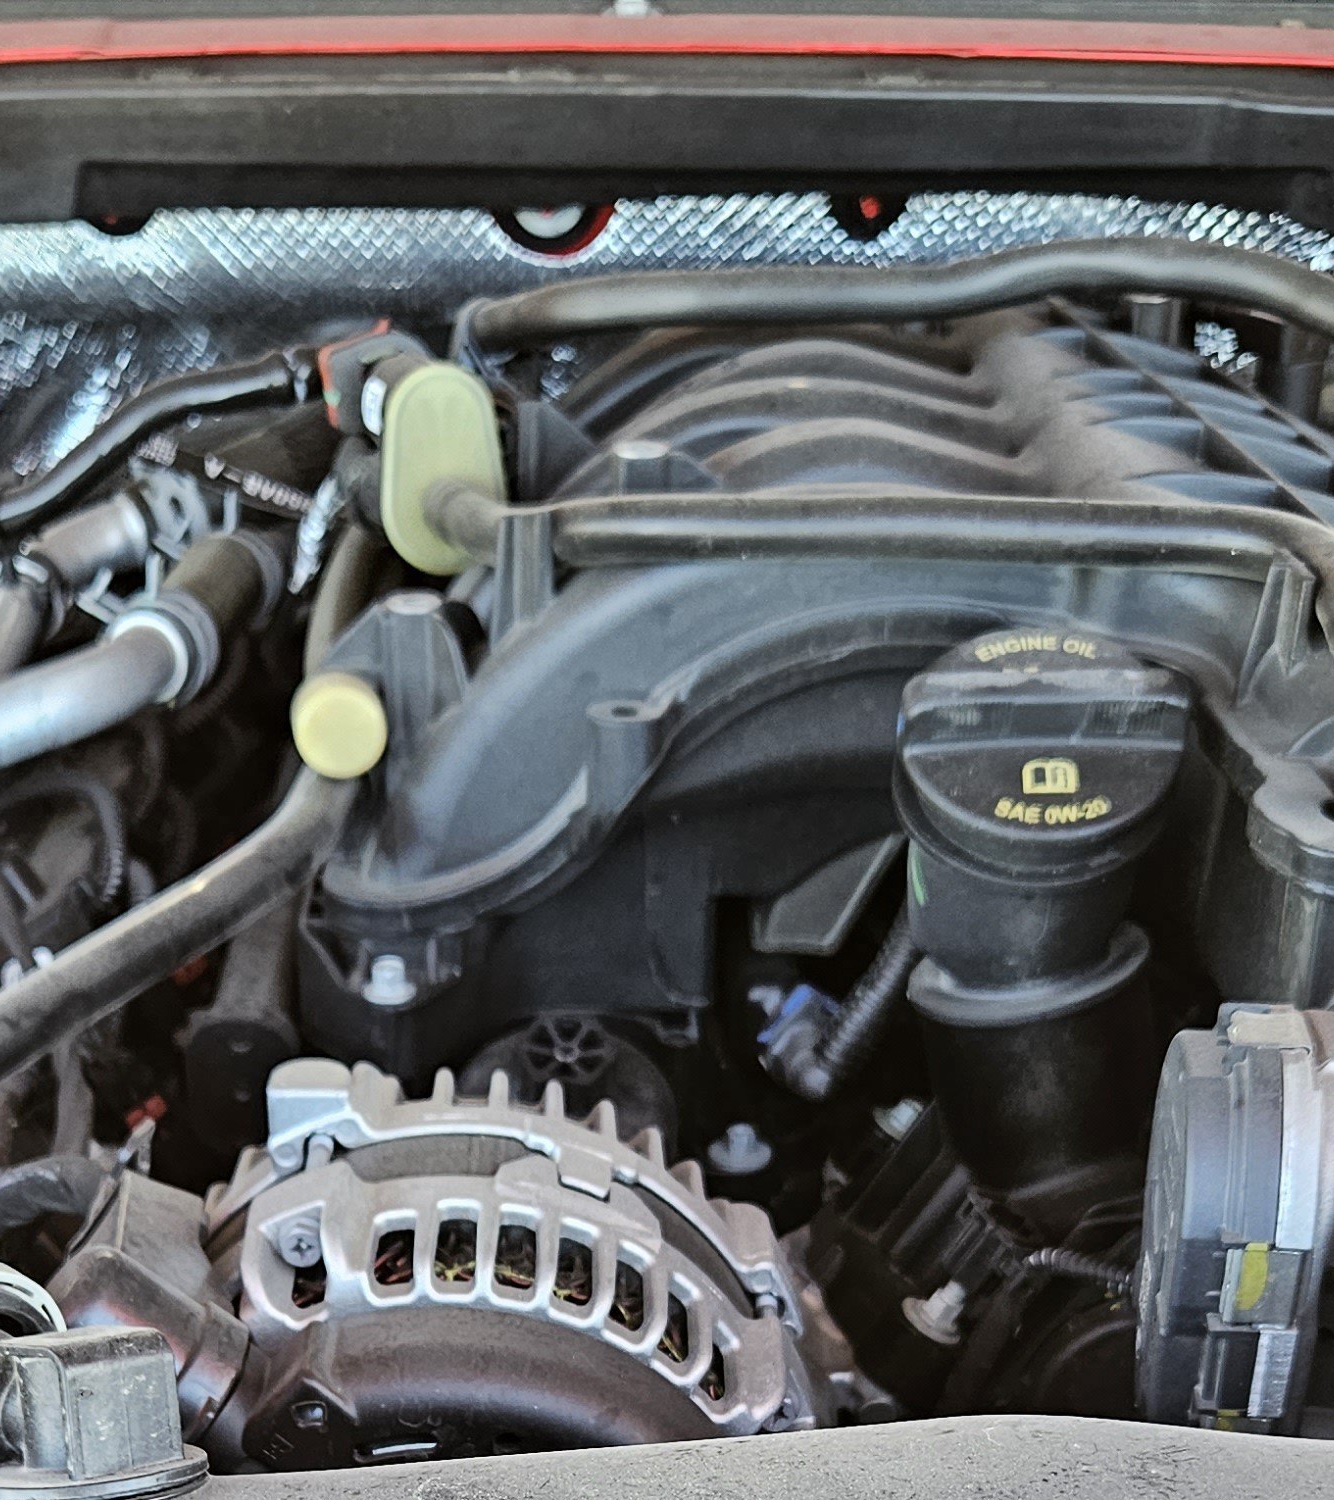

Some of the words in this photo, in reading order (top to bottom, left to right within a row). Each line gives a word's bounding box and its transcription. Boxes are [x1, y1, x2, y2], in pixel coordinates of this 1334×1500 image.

[974, 635, 1058, 662] ENGINE
[1062, 638, 1097, 660] OIL
[994, 797, 1040, 824] SAE
